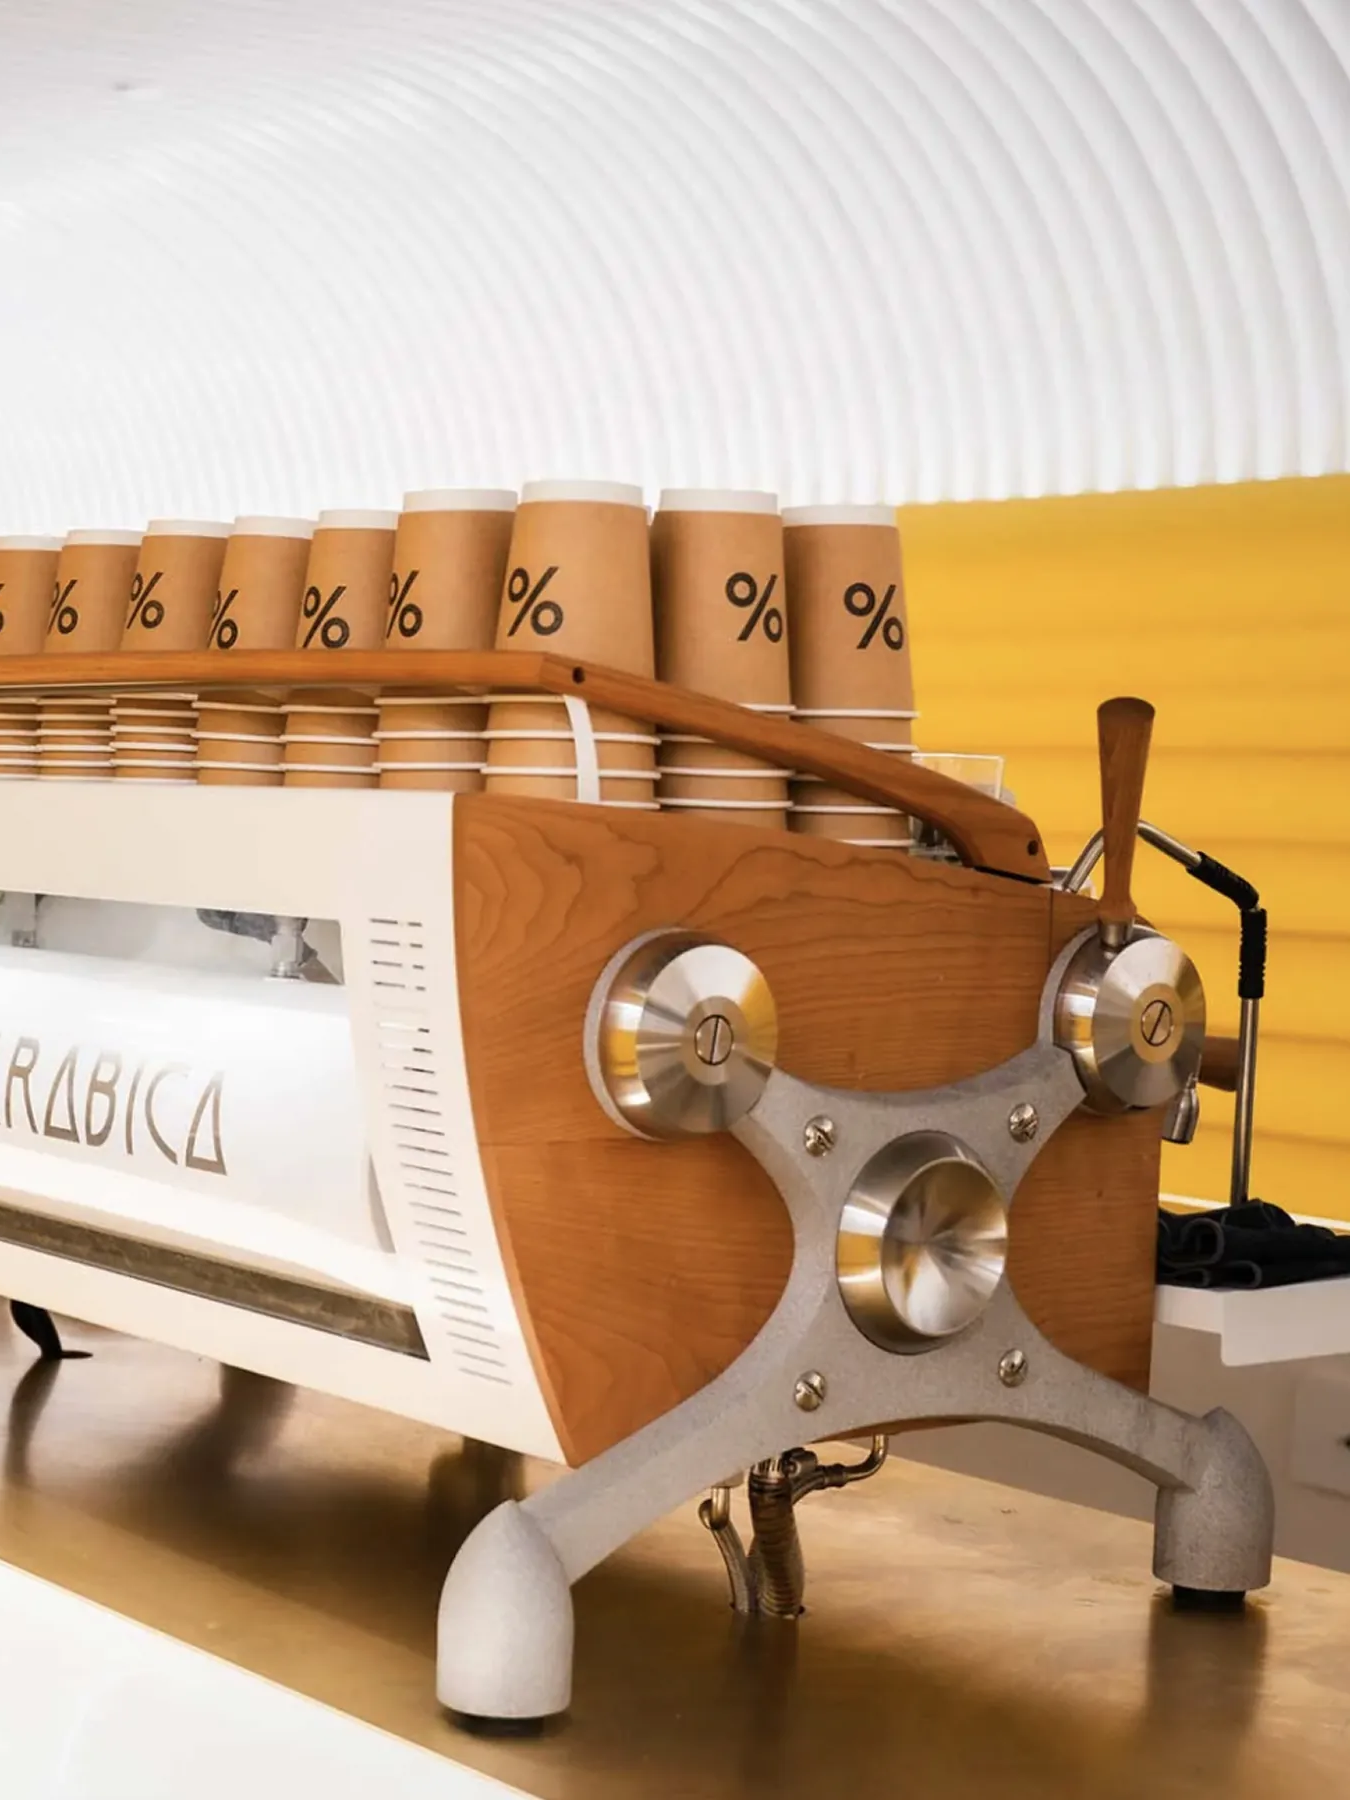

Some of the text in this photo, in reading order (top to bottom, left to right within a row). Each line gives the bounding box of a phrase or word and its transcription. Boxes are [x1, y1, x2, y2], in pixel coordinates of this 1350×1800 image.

[126, 571, 164, 630] %
[302, 586, 350, 648] %
[386, 570, 423, 639] %
[507, 566, 564, 637] %
[725, 571, 783, 643] %
[843, 582, 904, 650] %
